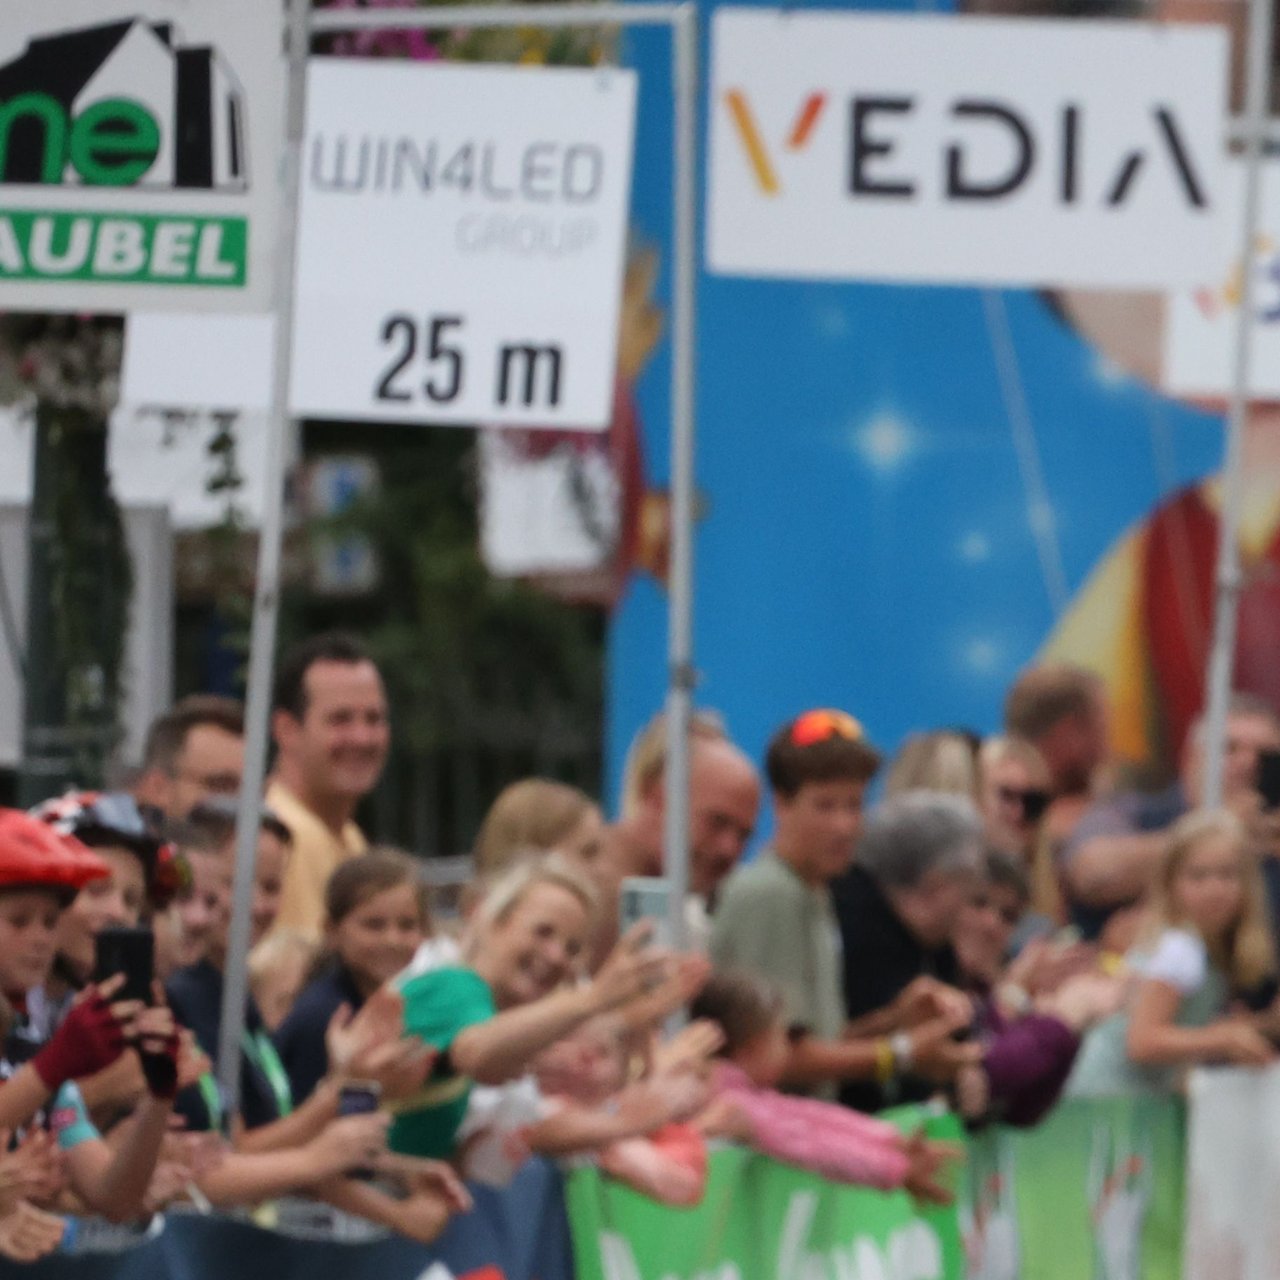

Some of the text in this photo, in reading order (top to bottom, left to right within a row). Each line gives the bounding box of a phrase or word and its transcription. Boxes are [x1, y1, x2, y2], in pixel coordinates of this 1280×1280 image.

[311, 132, 604, 202] WIN4LED
[723, 88, 1208, 208] VEDIA
[455, 212, 600, 256] GROUP
[374, 312, 563, 408] 25 m
